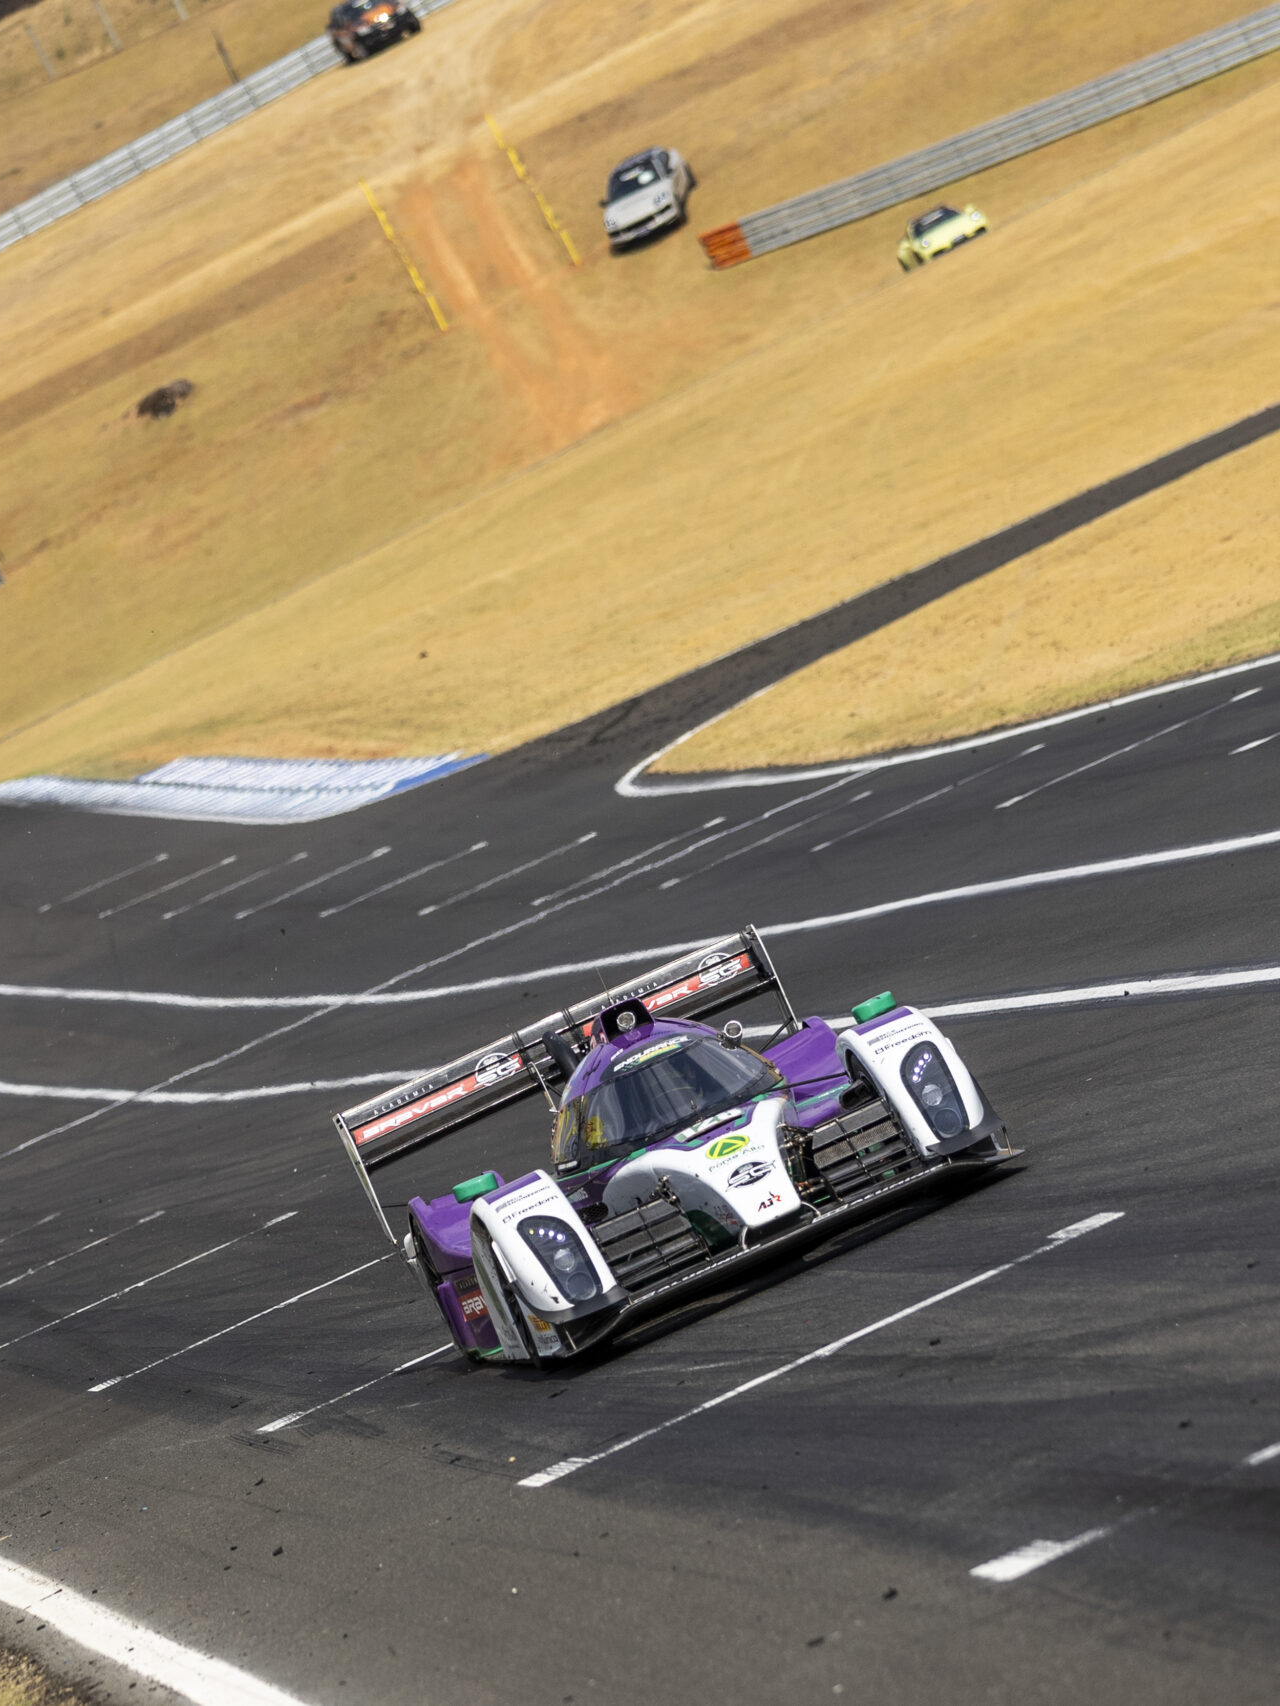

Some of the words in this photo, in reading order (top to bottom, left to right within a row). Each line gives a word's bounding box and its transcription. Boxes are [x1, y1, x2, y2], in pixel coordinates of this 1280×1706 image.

[885, 1030, 932, 1050] Freedom
[613, 1035, 691, 1072] ENDURANCE
[373, 1083, 434, 1116] ACADEMIA
[511, 1194, 559, 1217] Freedom
[758, 1191, 781, 1212] AJR
